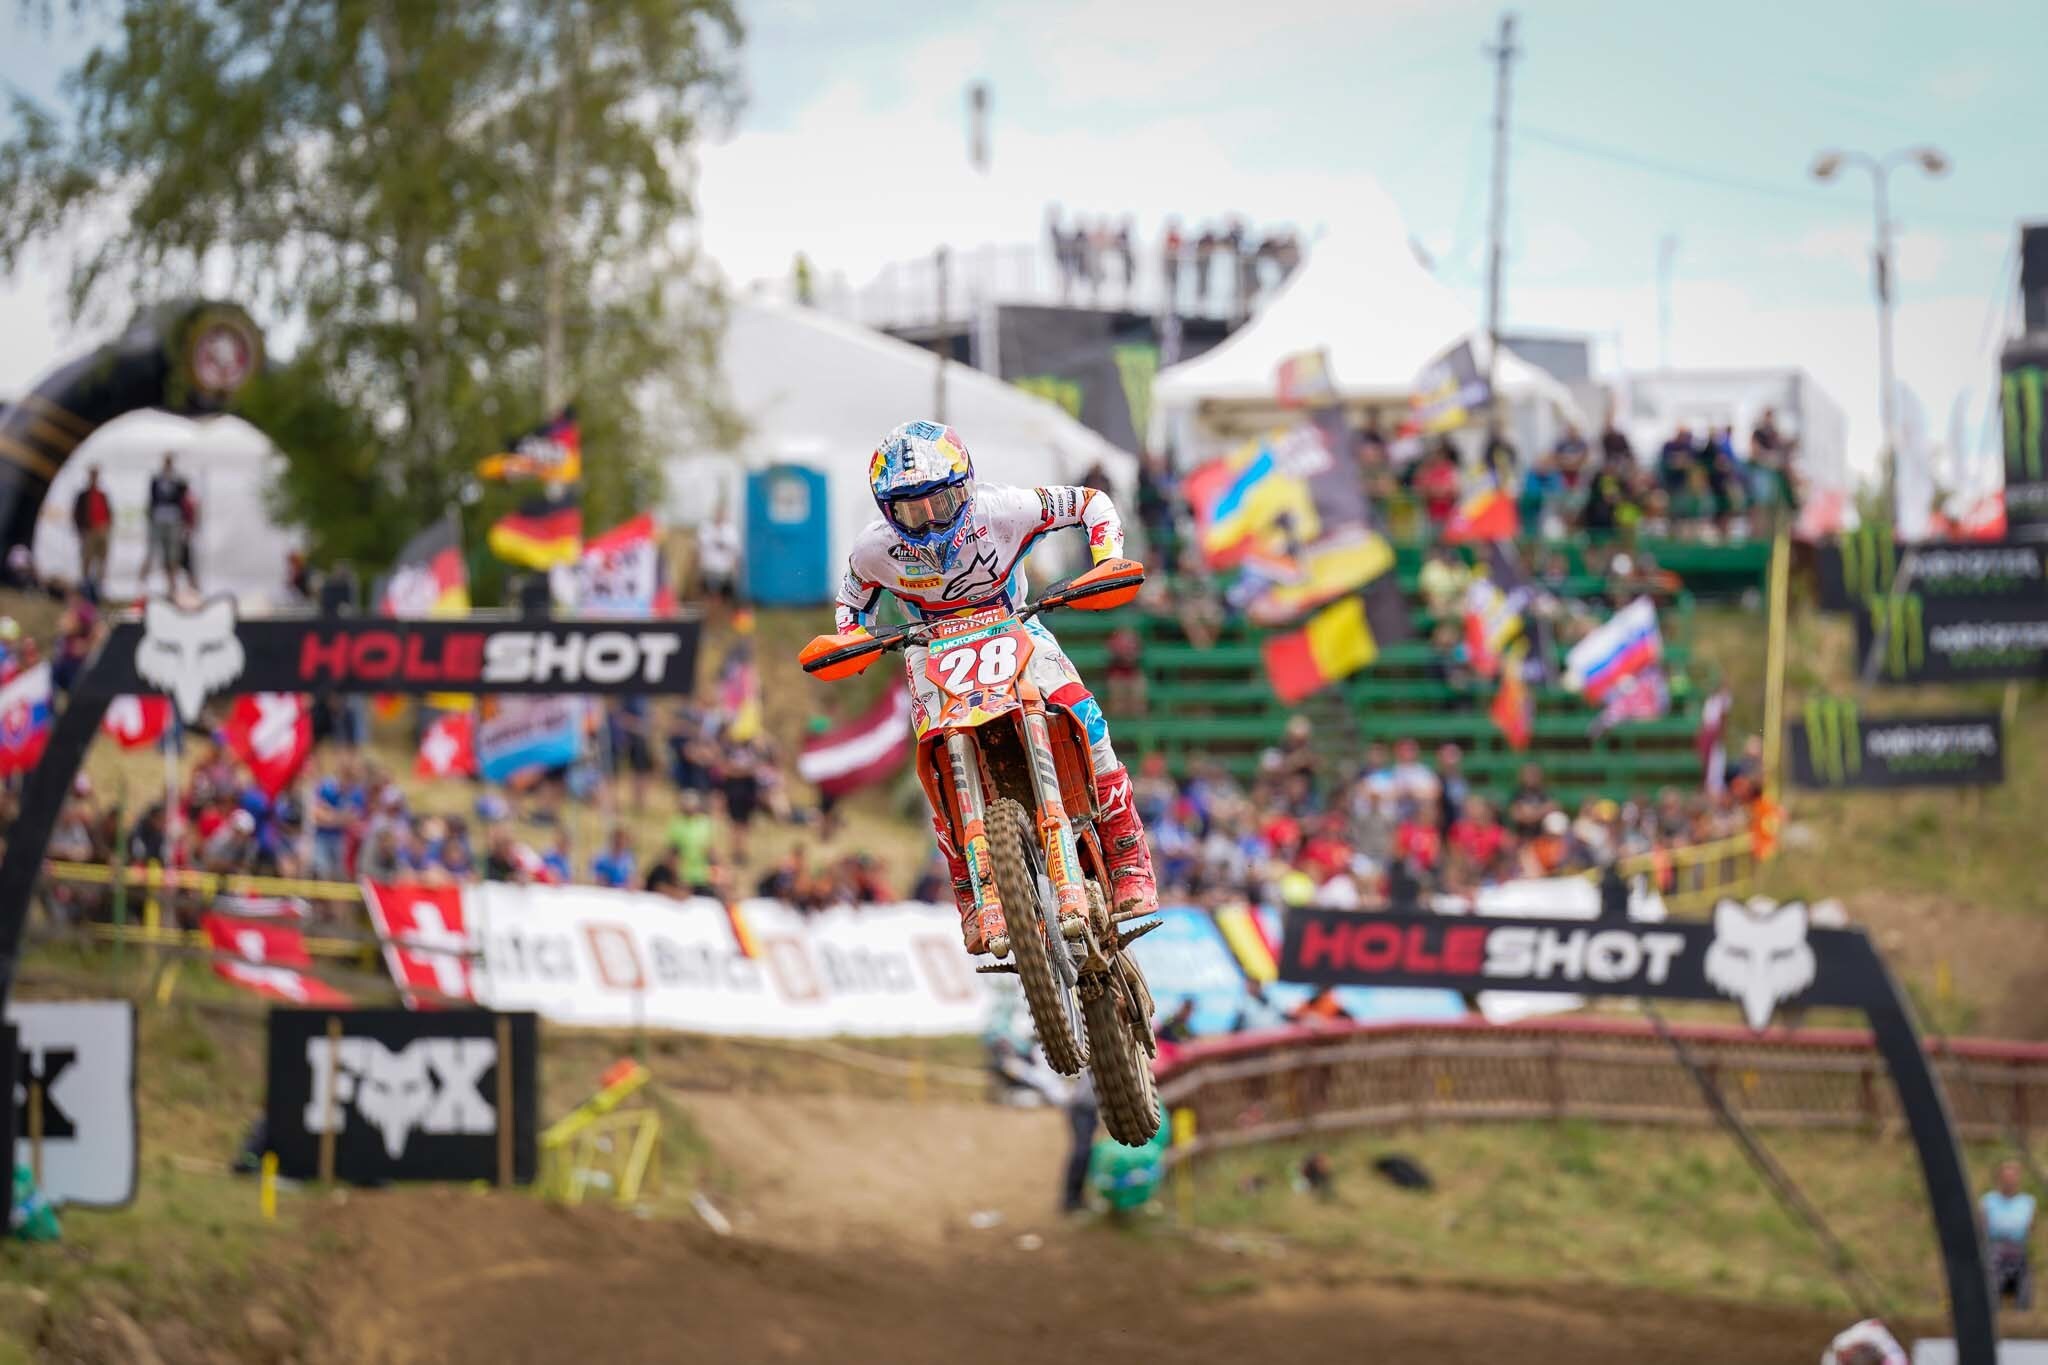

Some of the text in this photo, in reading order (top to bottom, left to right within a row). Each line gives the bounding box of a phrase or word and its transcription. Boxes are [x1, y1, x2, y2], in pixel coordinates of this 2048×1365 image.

[942, 630, 990, 650] MOTOREX
[943, 614, 1001, 635] RENTHAL
[301, 632, 681, 684] HOLESHOT
[939, 636, 1018, 695] 28
[1300, 920, 1686, 984] HOLESHOT
